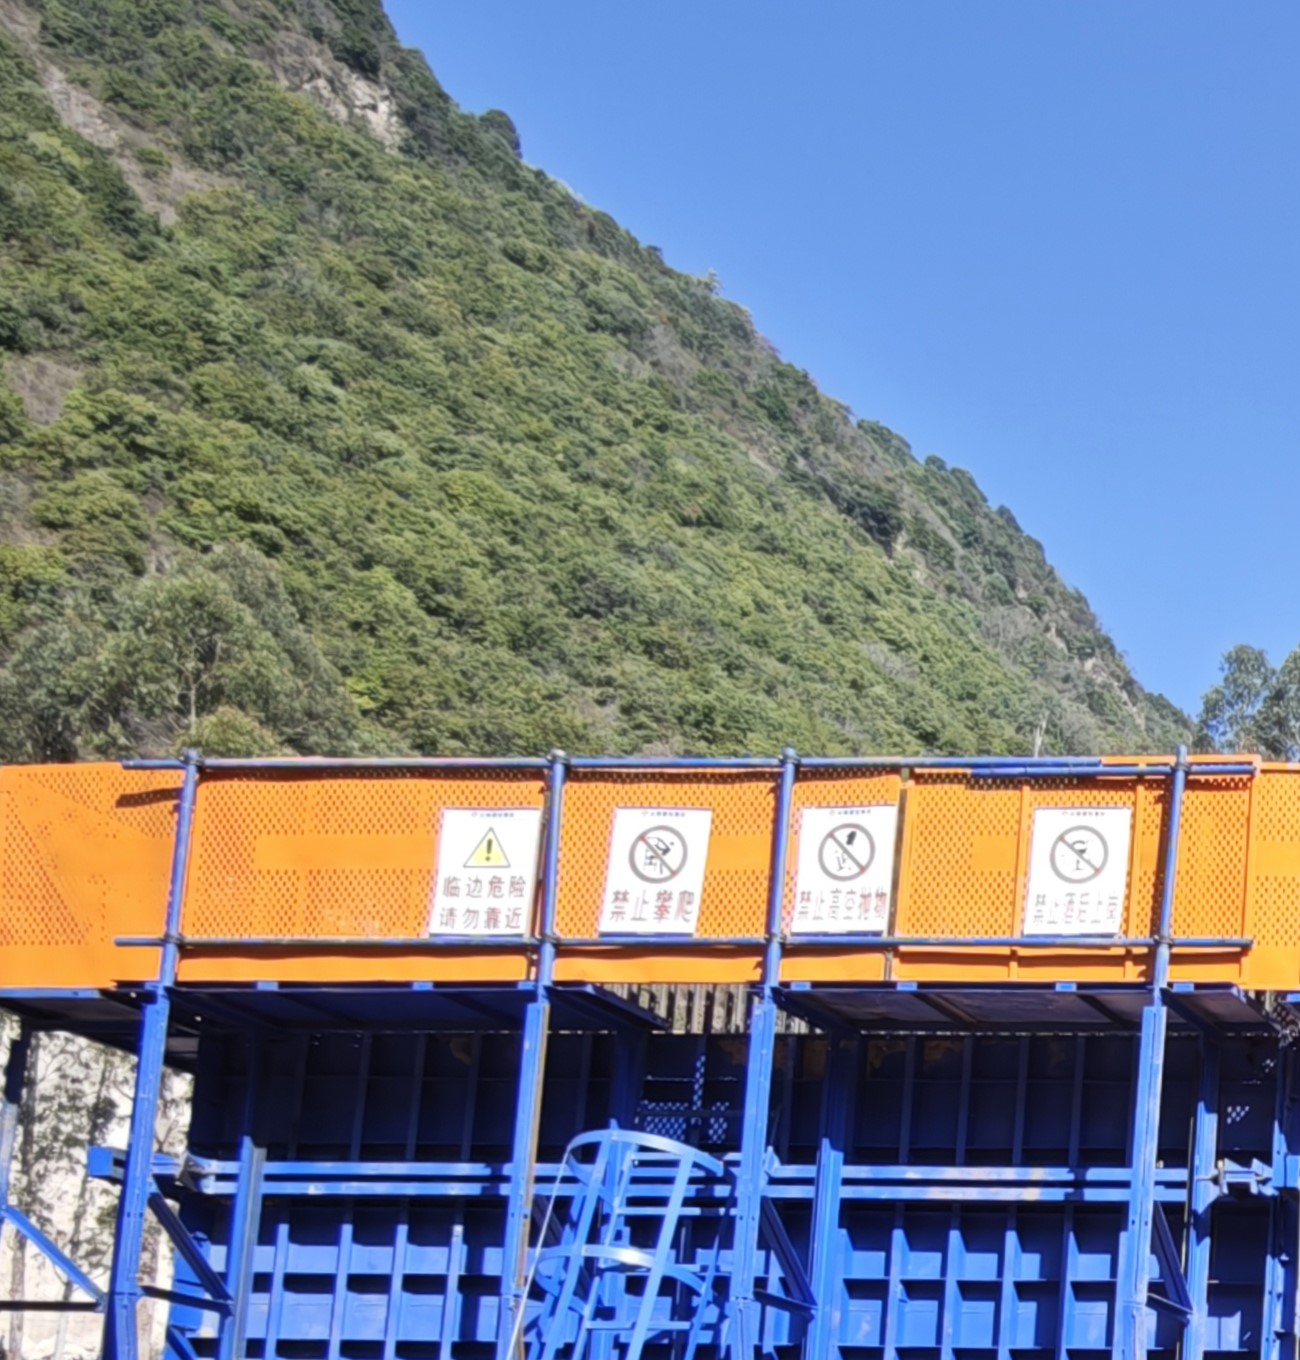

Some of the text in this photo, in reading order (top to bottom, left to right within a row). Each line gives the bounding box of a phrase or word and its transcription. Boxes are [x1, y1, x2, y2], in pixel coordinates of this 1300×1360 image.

[442, 875, 527, 899] 临边危险
[439, 906, 522, 929] 请勿靠近
[609, 889, 695, 923] 禁止攀爬
